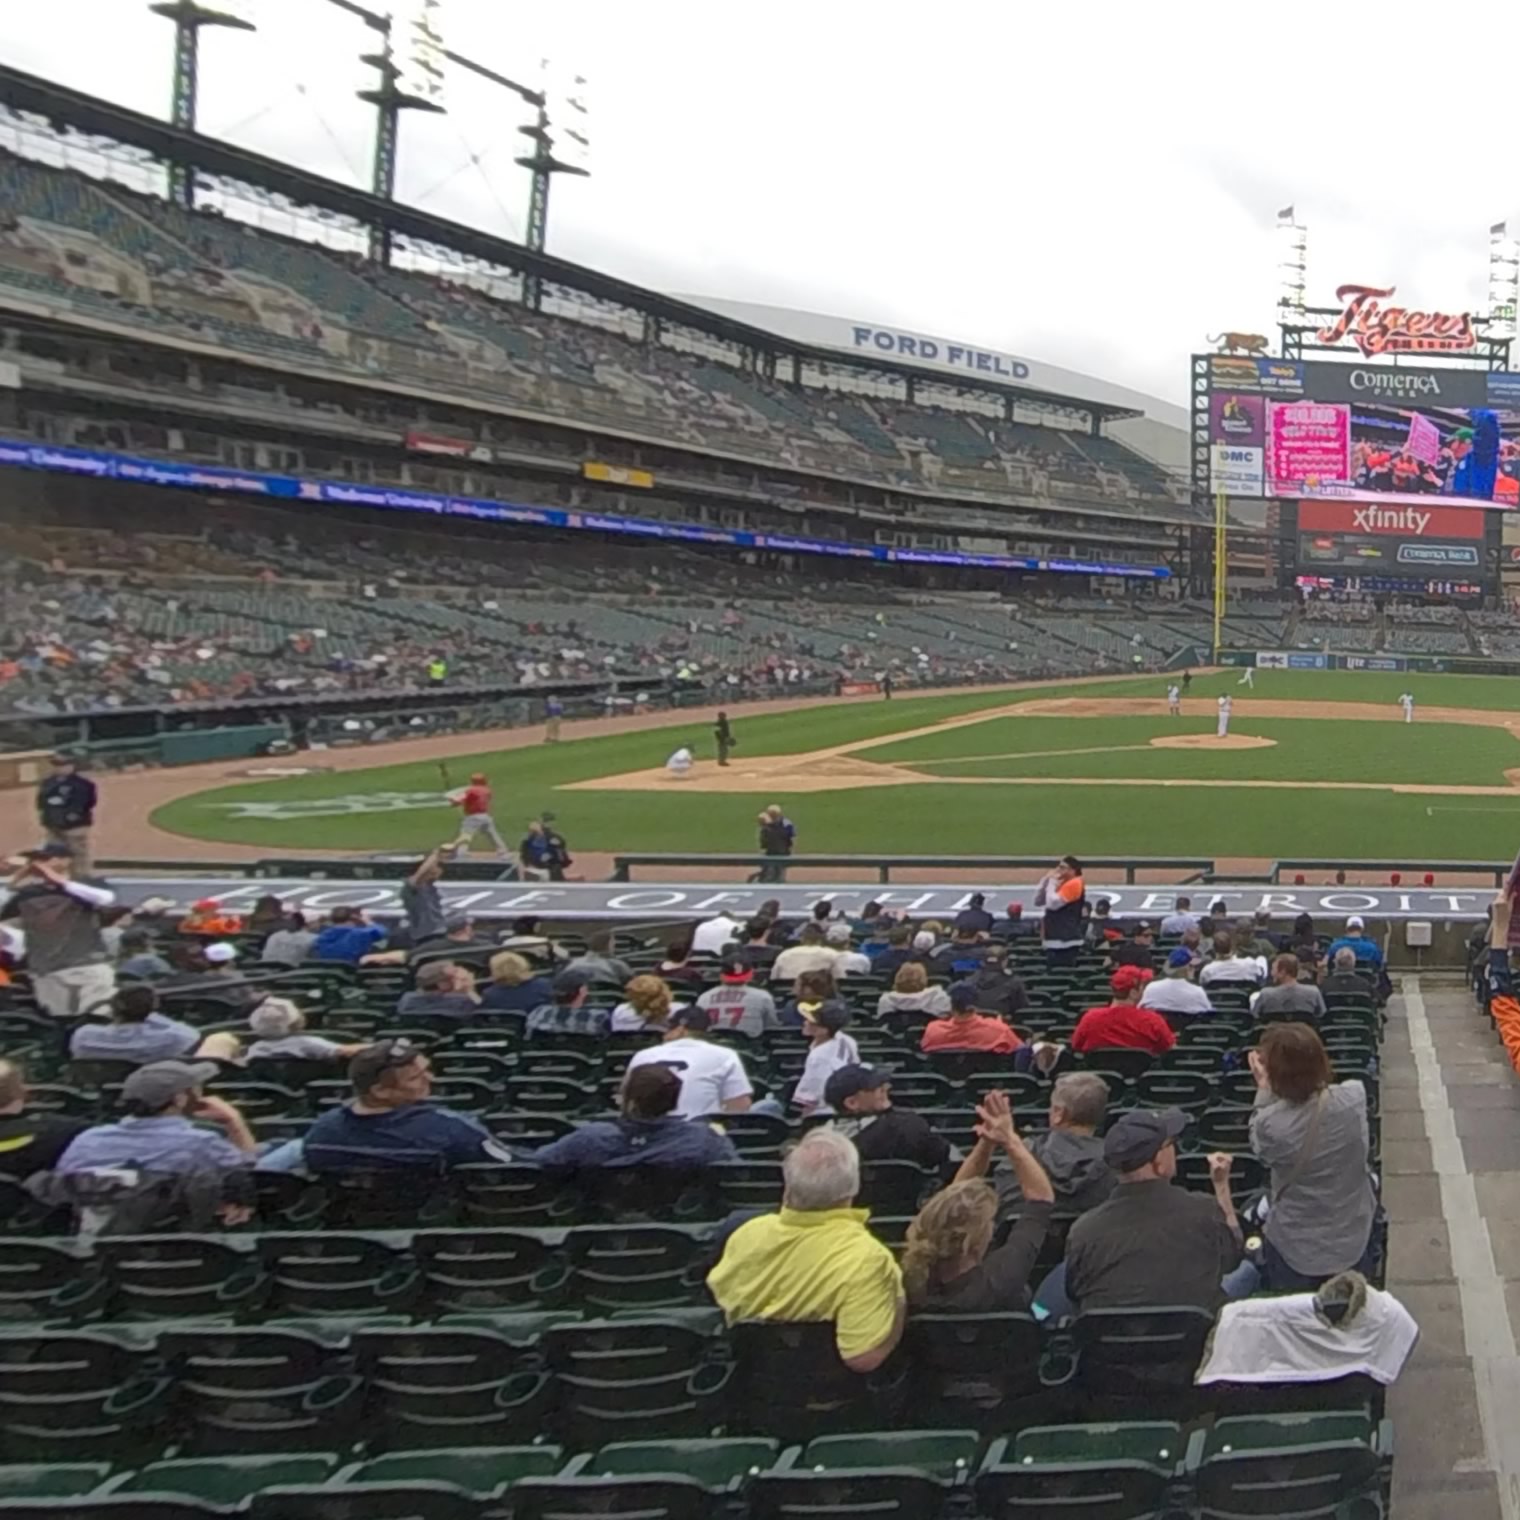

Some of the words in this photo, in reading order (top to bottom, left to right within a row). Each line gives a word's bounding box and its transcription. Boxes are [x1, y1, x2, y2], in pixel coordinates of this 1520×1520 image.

[1317, 284, 1472, 351] Tigers
[853, 326, 939, 359] FORD
[947, 345, 1029, 379] FIELD
[1220, 450, 1254, 462] DMC
[1353, 505, 1430, 535] xfinity
[606, 890, 752, 909] OF
